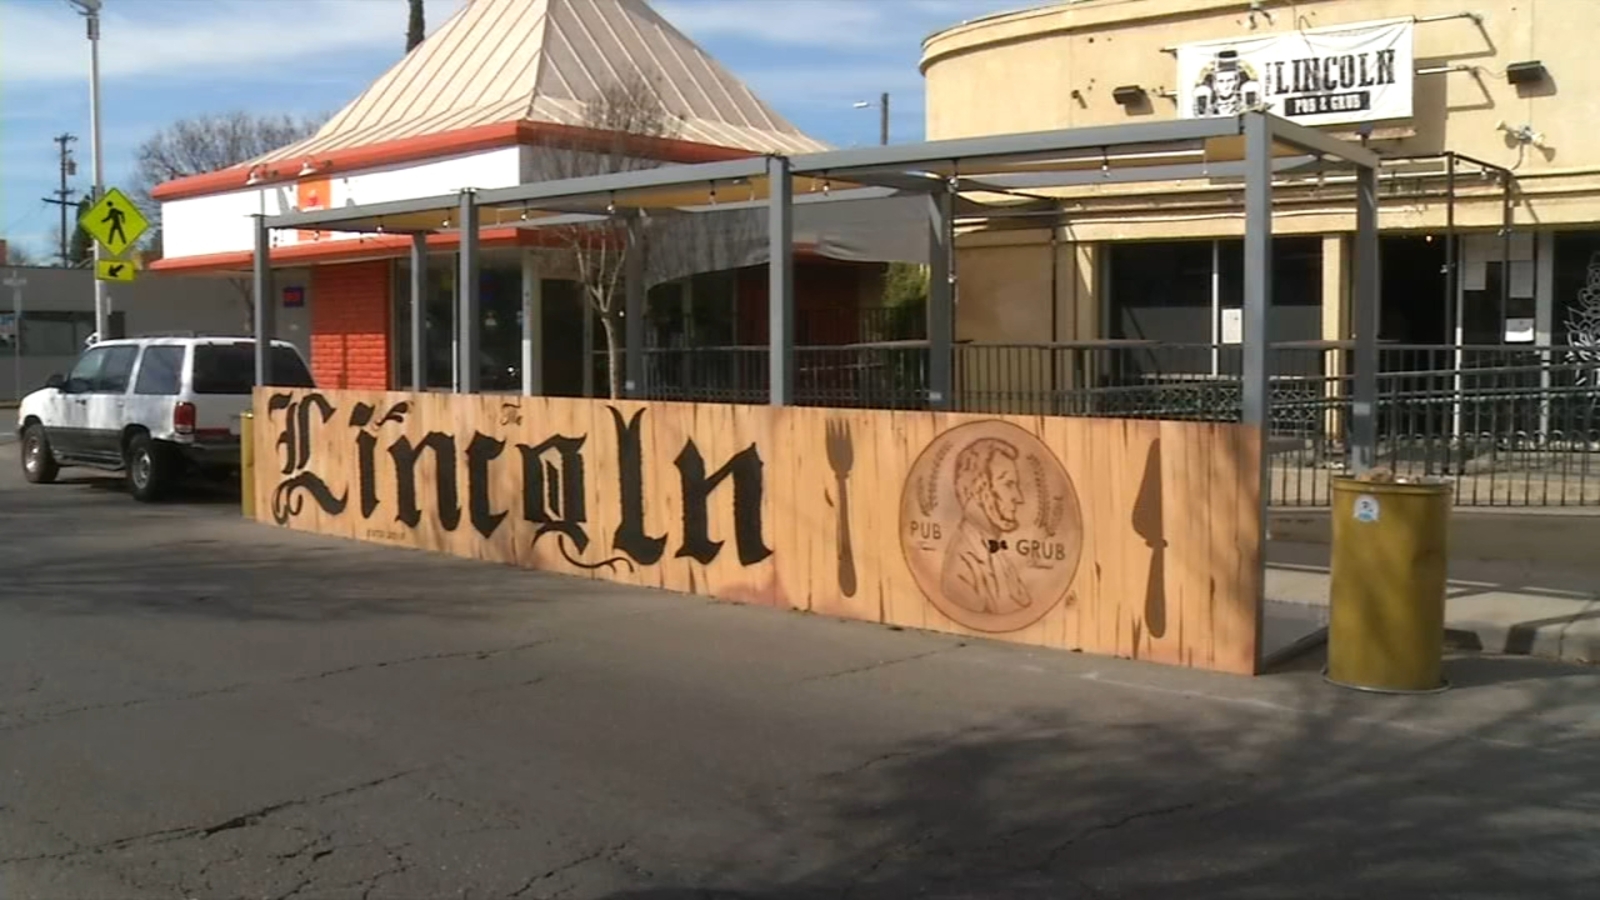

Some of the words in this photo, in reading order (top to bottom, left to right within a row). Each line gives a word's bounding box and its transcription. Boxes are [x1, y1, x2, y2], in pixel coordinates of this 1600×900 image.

[1274, 49, 1396, 95] LINCOLN
[268, 391, 775, 573] Lincoln
[910, 520, 942, 540] PUB
[1016, 539, 1066, 560] GRUB
